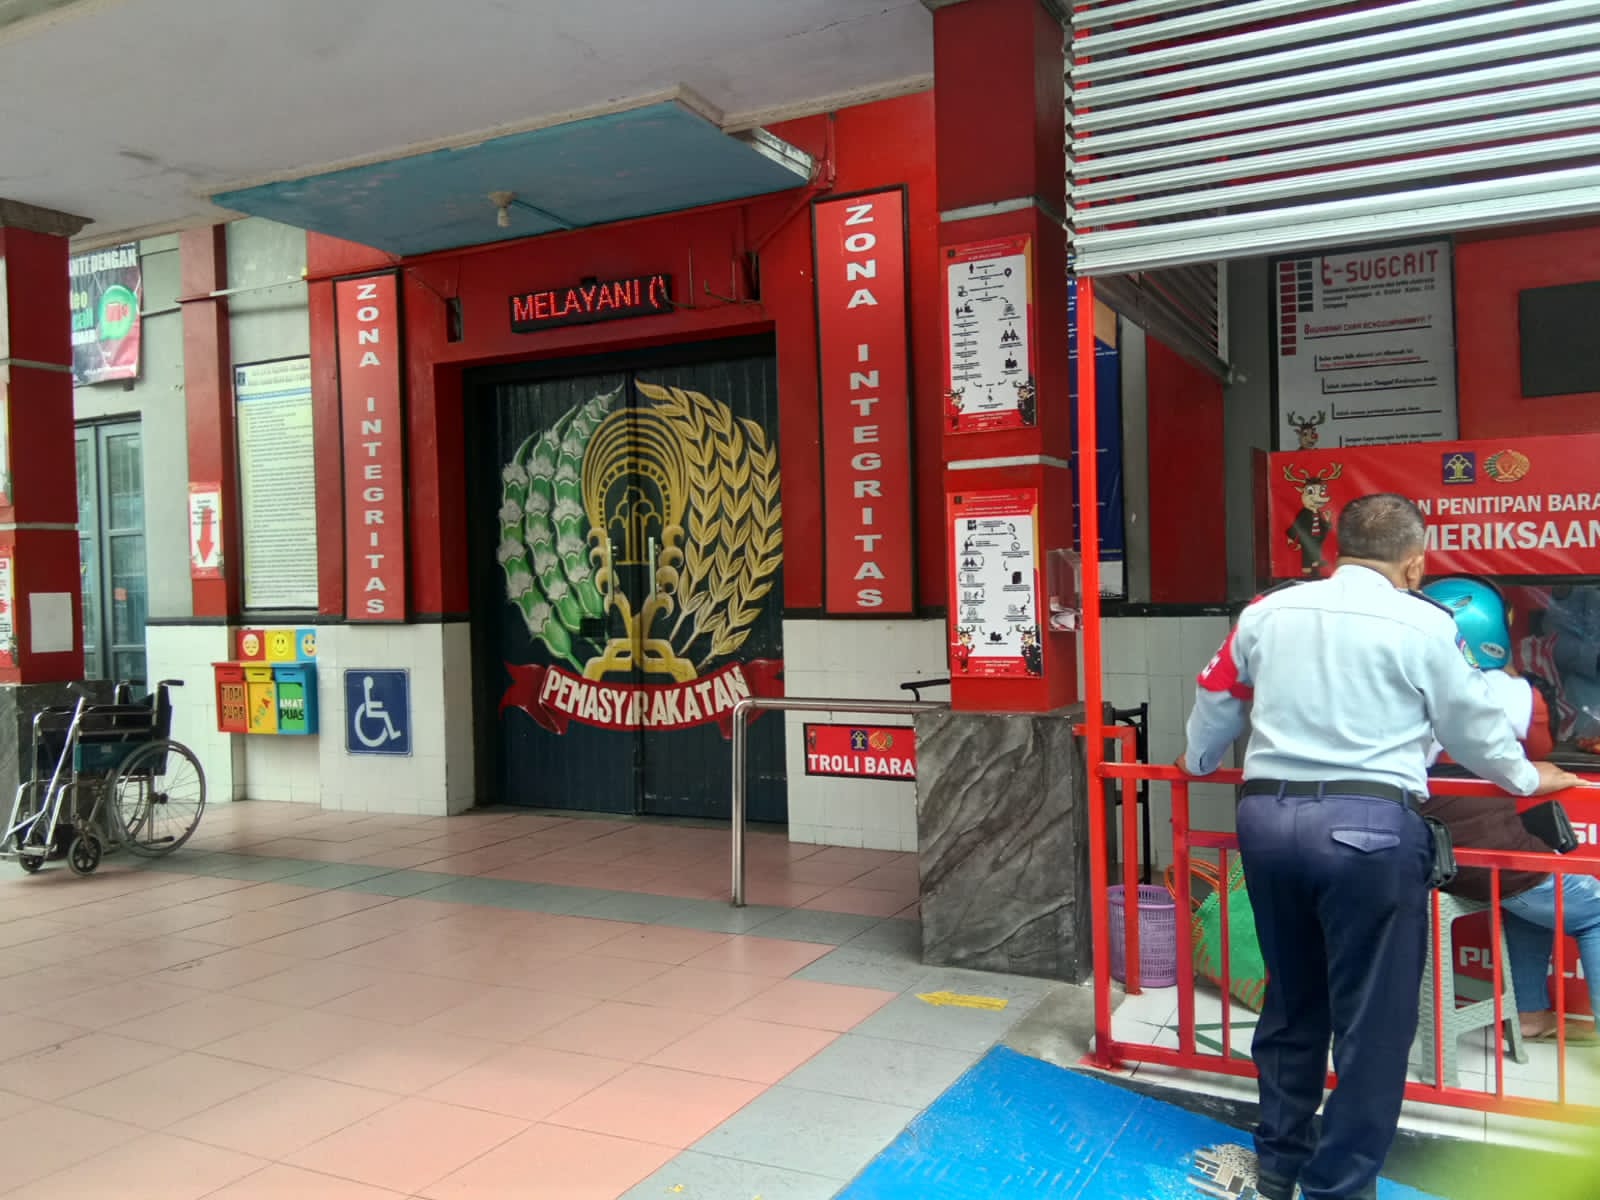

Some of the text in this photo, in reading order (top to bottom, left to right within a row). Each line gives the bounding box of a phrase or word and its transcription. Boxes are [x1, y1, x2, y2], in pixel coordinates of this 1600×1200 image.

[513, 279, 640, 321] MELAYANI
[844, 203, 885, 608] ZONA INTEGRITAS
[357, 283, 386, 614] ZONA INTEGRITAS
[1437, 495, 1541, 515] PENITIPAN
[280, 708, 304, 721] PUAS
[542, 666, 751, 726] PEMASYARAKATAN
[808, 753, 860, 772] TROLI
